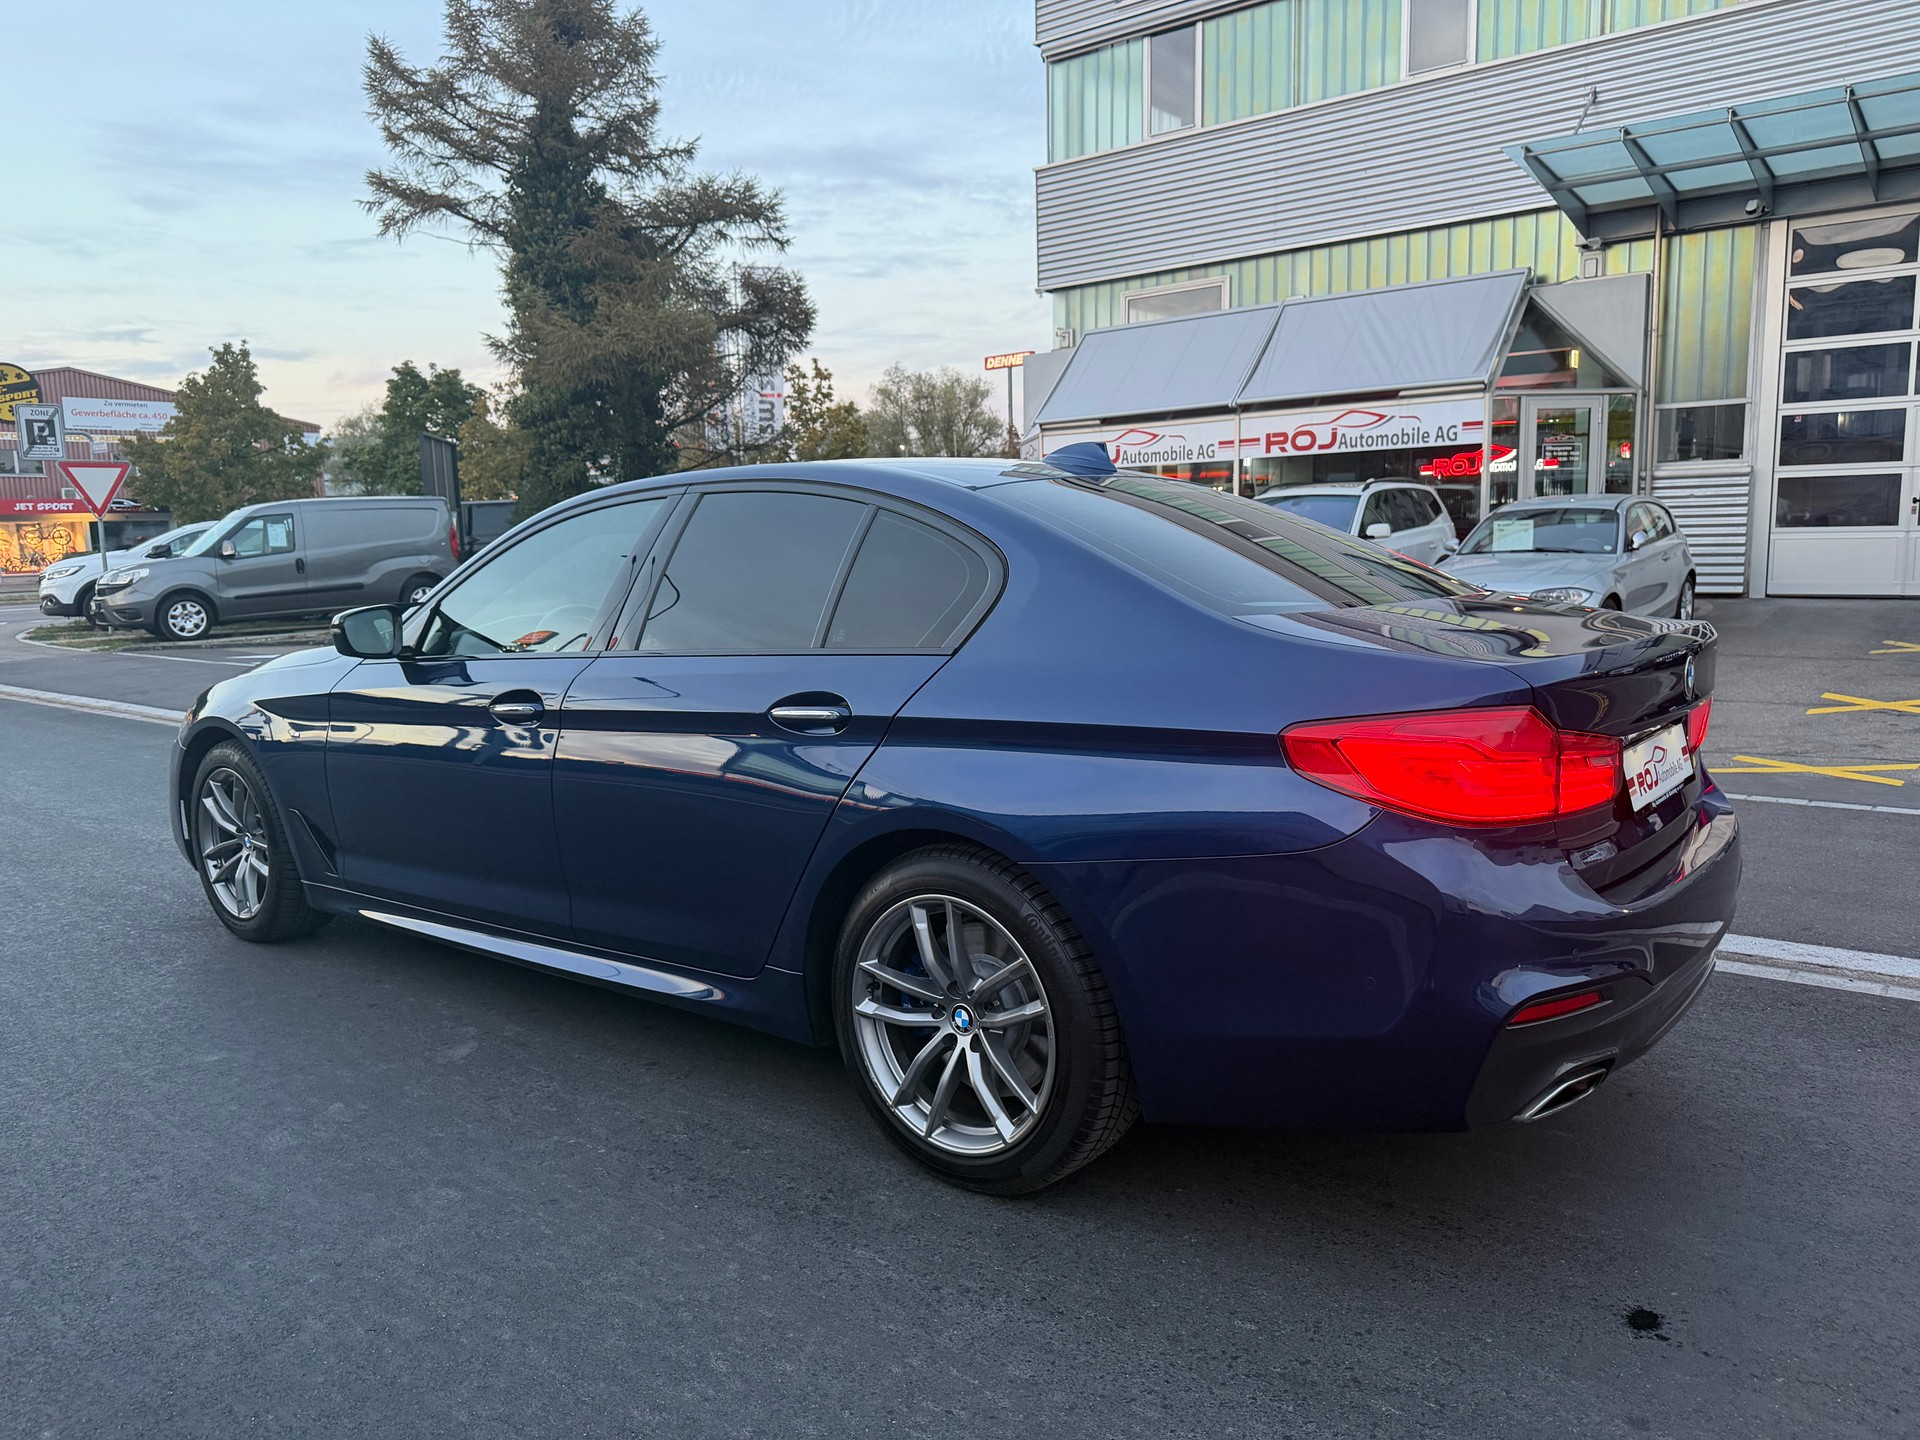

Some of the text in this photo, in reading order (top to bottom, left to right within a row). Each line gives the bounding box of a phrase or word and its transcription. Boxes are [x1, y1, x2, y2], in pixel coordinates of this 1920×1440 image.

[986, 352, 1030, 369] DENNE
[30, 409, 50, 417] ZONE
[70, 408, 137, 419] Gewerbefläche
[152, 412, 168, 420] 450
[1265, 424, 1458, 454] ROJ Automobile AG
[1121, 445, 1194, 465] Automobile
[1196, 443, 1215, 460] AG
[14, 502, 74, 511] JET SPORT
[1636, 763, 1659, 797] ROJ
